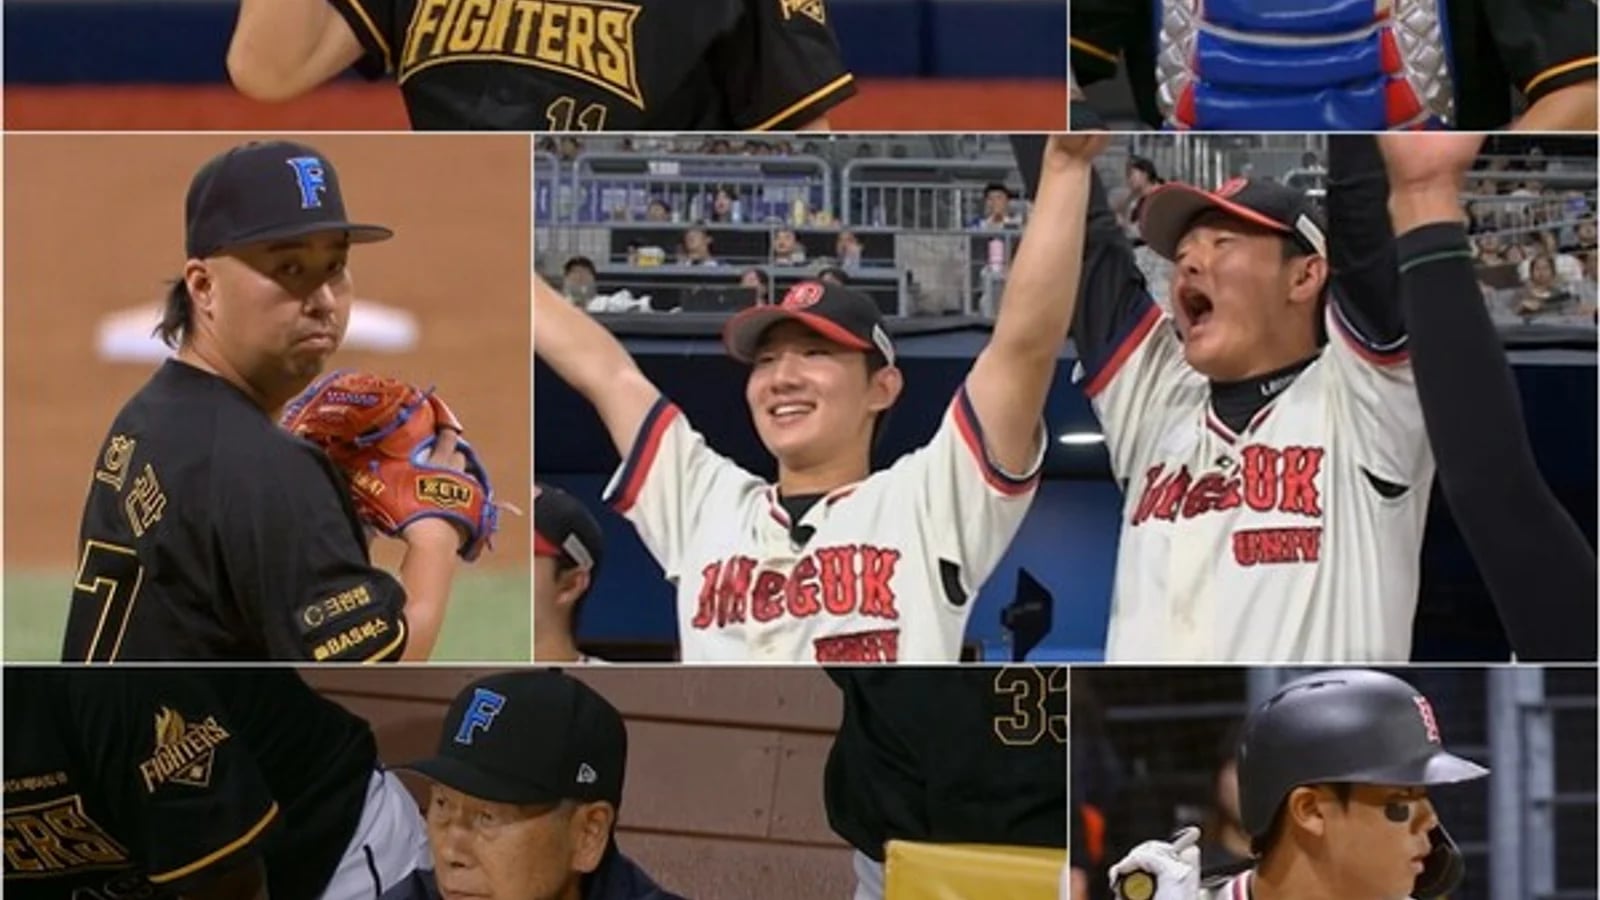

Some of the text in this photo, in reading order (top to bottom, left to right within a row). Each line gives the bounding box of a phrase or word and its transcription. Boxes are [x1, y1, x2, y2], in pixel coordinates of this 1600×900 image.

[403, 0, 632, 89] FIGHTERS
[286, 157, 326, 209] F
[453, 688, 507, 744] F
[139, 715, 231, 792] FIGHTERS
